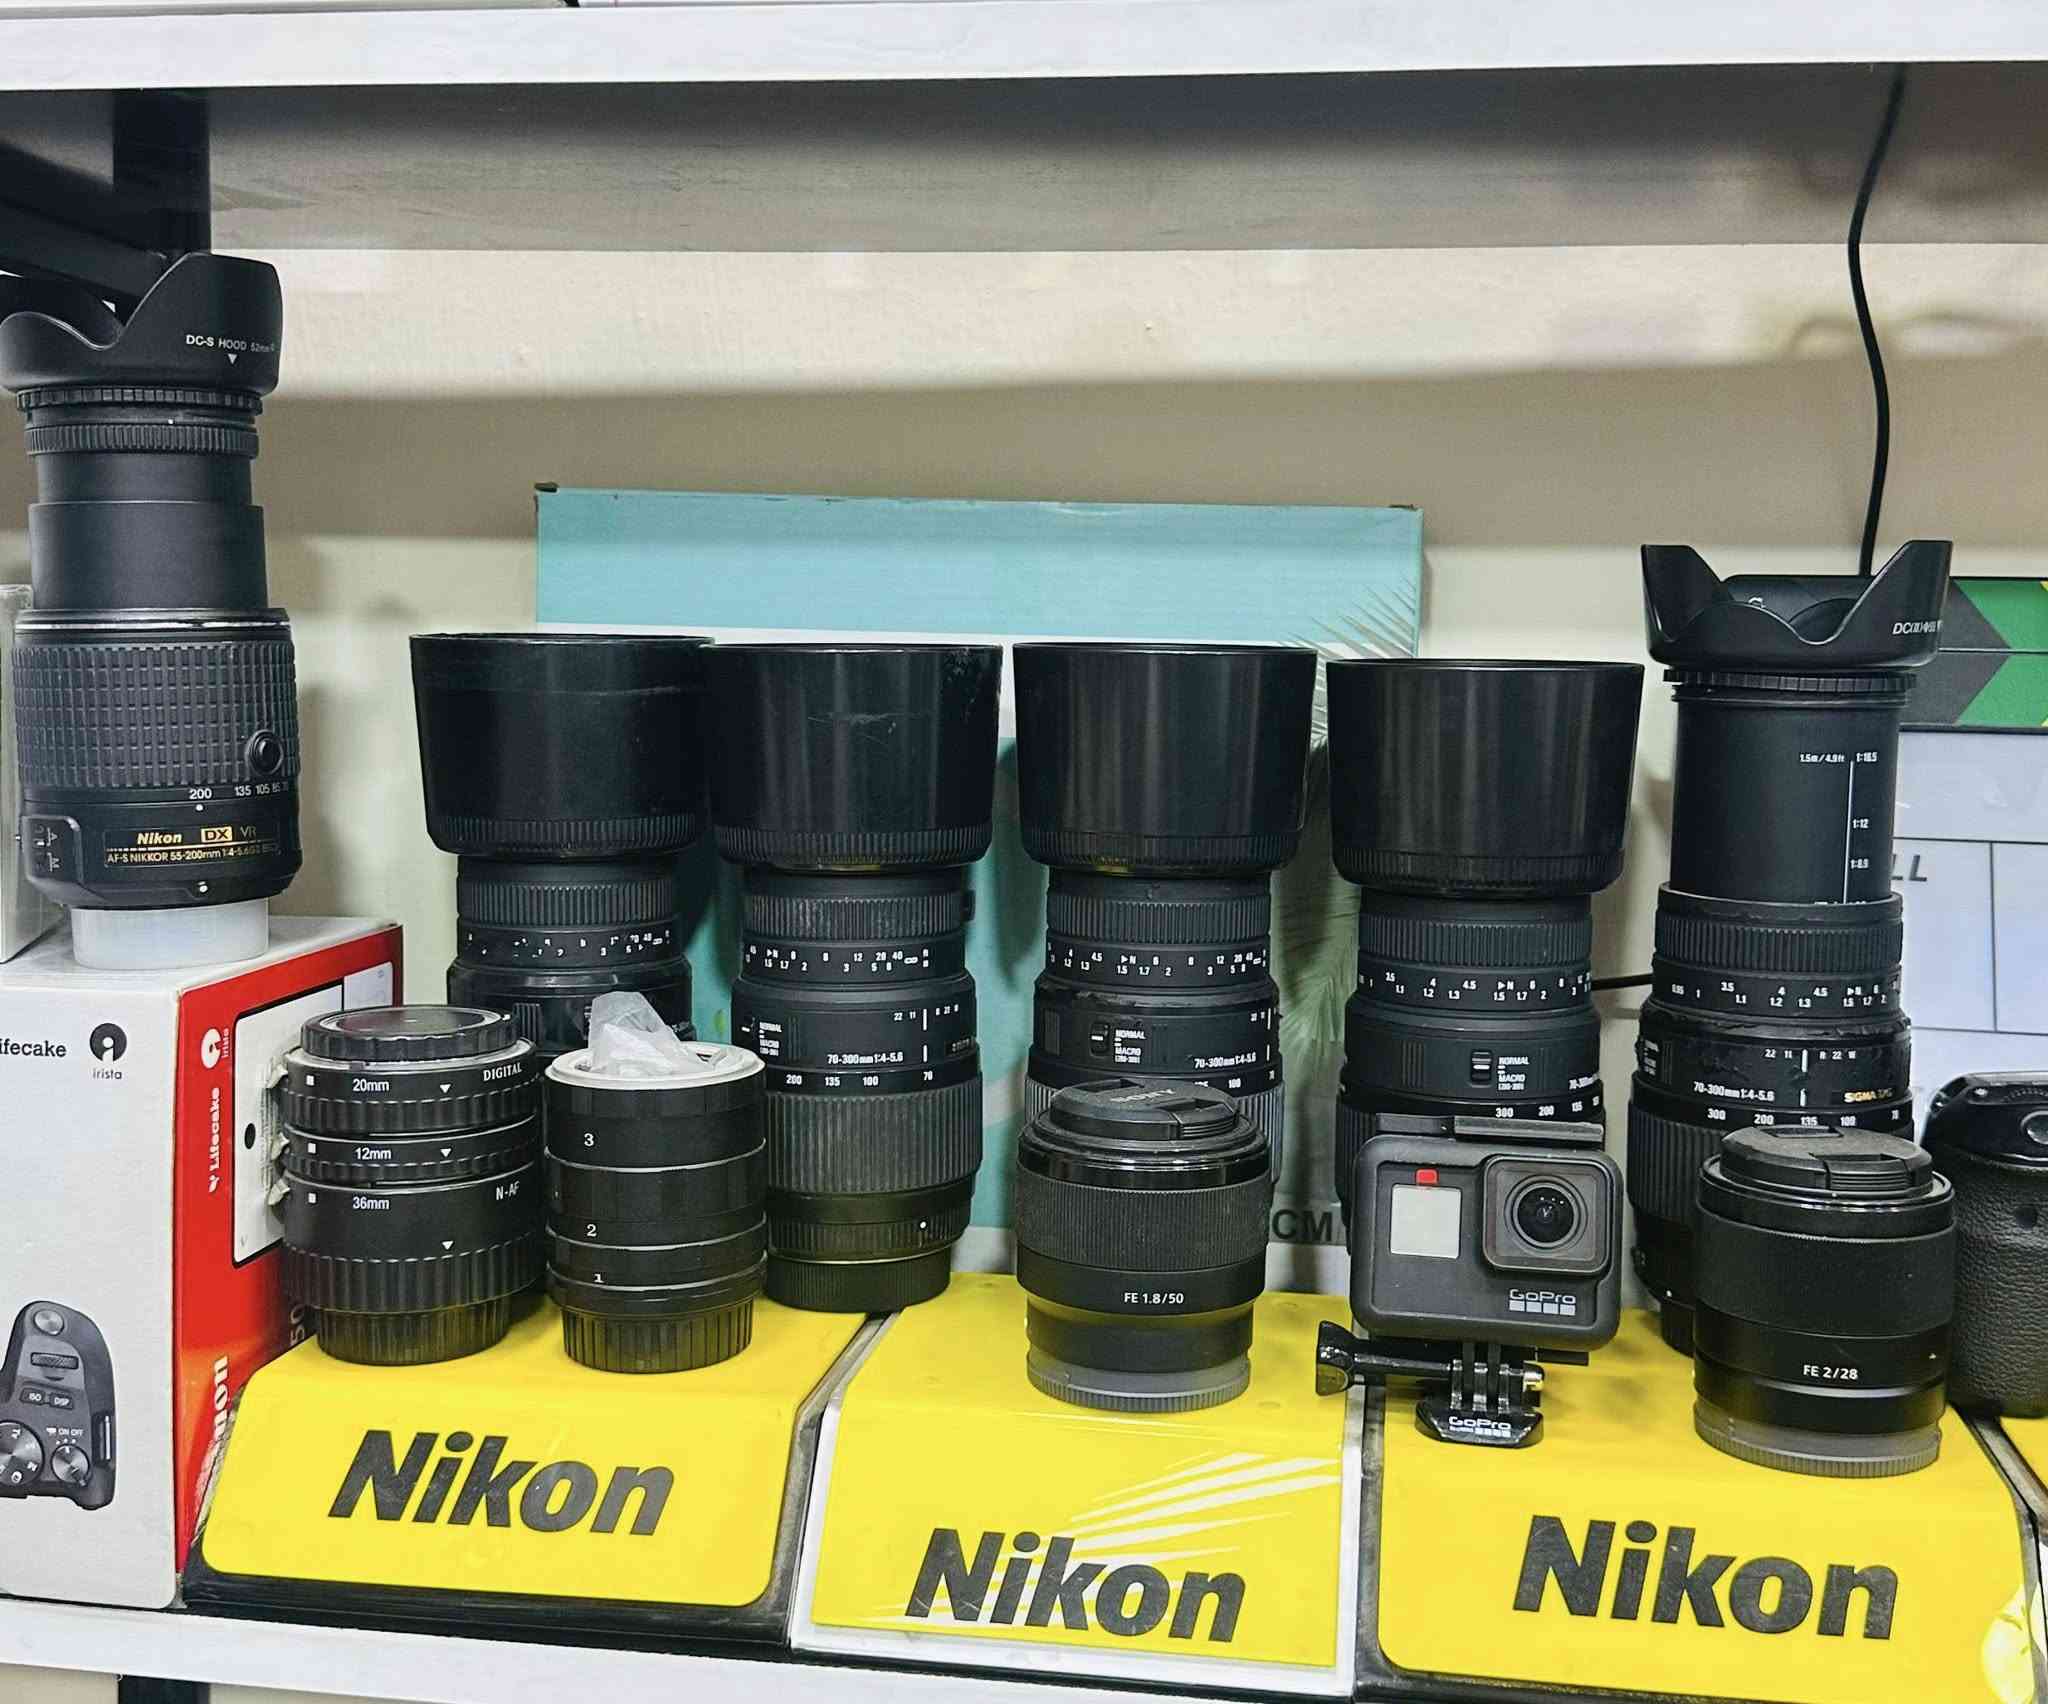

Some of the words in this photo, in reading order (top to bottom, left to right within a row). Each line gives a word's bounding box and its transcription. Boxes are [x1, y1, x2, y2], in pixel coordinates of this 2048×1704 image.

[186, 334, 214, 347] DC-S
[218, 338, 247, 351] HOOD
[188, 788, 212, 800] 200
[234, 785, 252, 797] 135
[255, 783, 270, 795] 105
[137, 832, 182, 845] Nikon
[204, 829, 230, 841] DX
[107, 852, 128, 864] AF-S
[130, 851, 169, 863] NIKKOR
[170, 848, 221, 862] 55-200mm
[854, 952, 863, 962] 12
[876, 952, 887, 961] 20
[892, 951, 903, 960] 40
[802, 962, 808, 971] 2
[843, 963, 850, 972] 3
[872, 963, 878, 972] 5
[1117, 965, 1128, 975] 1.5
[1139, 966, 1150, 976] 1.7
[1165, 967, 1172, 976] 2
[1207, 966, 1213, 976] 3
[1463, 980, 1476, 990] 4.5
[1778, 986, 1786, 996] 4
[1813, 987, 1828, 997] 4.5
[1423, 988, 1434, 998] 1.2
[1448, 990, 1460, 1000] 1.3
[1494, 992, 1505, 1001] 1.5
[1517, 991, 1528, 1001] 1.7
[1540, 990, 1547, 1000] 2
[1735, 994, 1747, 1004] 1.1
[1770, 997, 1784, 1007] 1.2
[1798, 998, 1811, 1008] 1.3
[1843, 998, 1854, 1007] 1.5
[0, 1038, 67, 1058] ifecake
[1115, 1046, 1142, 1056] MACRO
[1764, 1048, 1776, 1058] 22
[1784, 1050, 1792, 1059] 11
[1832, 1051, 1842, 1060] 22
[1498, 1056, 1530, 1065] NORMAL
[91, 1067, 122, 1080] irista
[482, 1062, 523, 1082] DIGITAL
[786, 1074, 802, 1085] 200
[824, 1076, 840, 1086] 135
[862, 1075, 879, 1086] 100
[923, 1070, 933, 1081] 70
[1498, 1073, 1526, 1082] MACRO
[352, 1078, 390, 1092] 20mm
[1496, 1107, 1514, 1118] 300
[1538, 1105, 1554, 1117] 200
[1707, 1108, 1726, 1120] 300
[1754, 1113, 1774, 1125] 200
[1801, 1116, 1818, 1126] 135
[1840, 1115, 1856, 1127] 100
[584, 1132, 595, 1147] 3
[355, 1147, 392, 1160] 12mm
[496, 1180, 521, 1201] N-AF
[352, 1195, 390, 1210] 36mm
[586, 1223, 597, 1237] 2
[1272, 1209, 1332, 1241] CM
[1124, 1292, 1139, 1304] FE
[1142, 1292, 1184, 1304] 1.8/50
[1510, 1288, 1576, 1304] GoPro
[1803, 1364, 1819, 1377] FE
[1823, 1367, 1858, 1380] 2/28
[1449, 1416, 1511, 1430] GoPro
[328, 1429, 674, 1536] Nikon
[1513, 1514, 1898, 1640] Nikon
[905, 1528, 1246, 1643] Nikon
